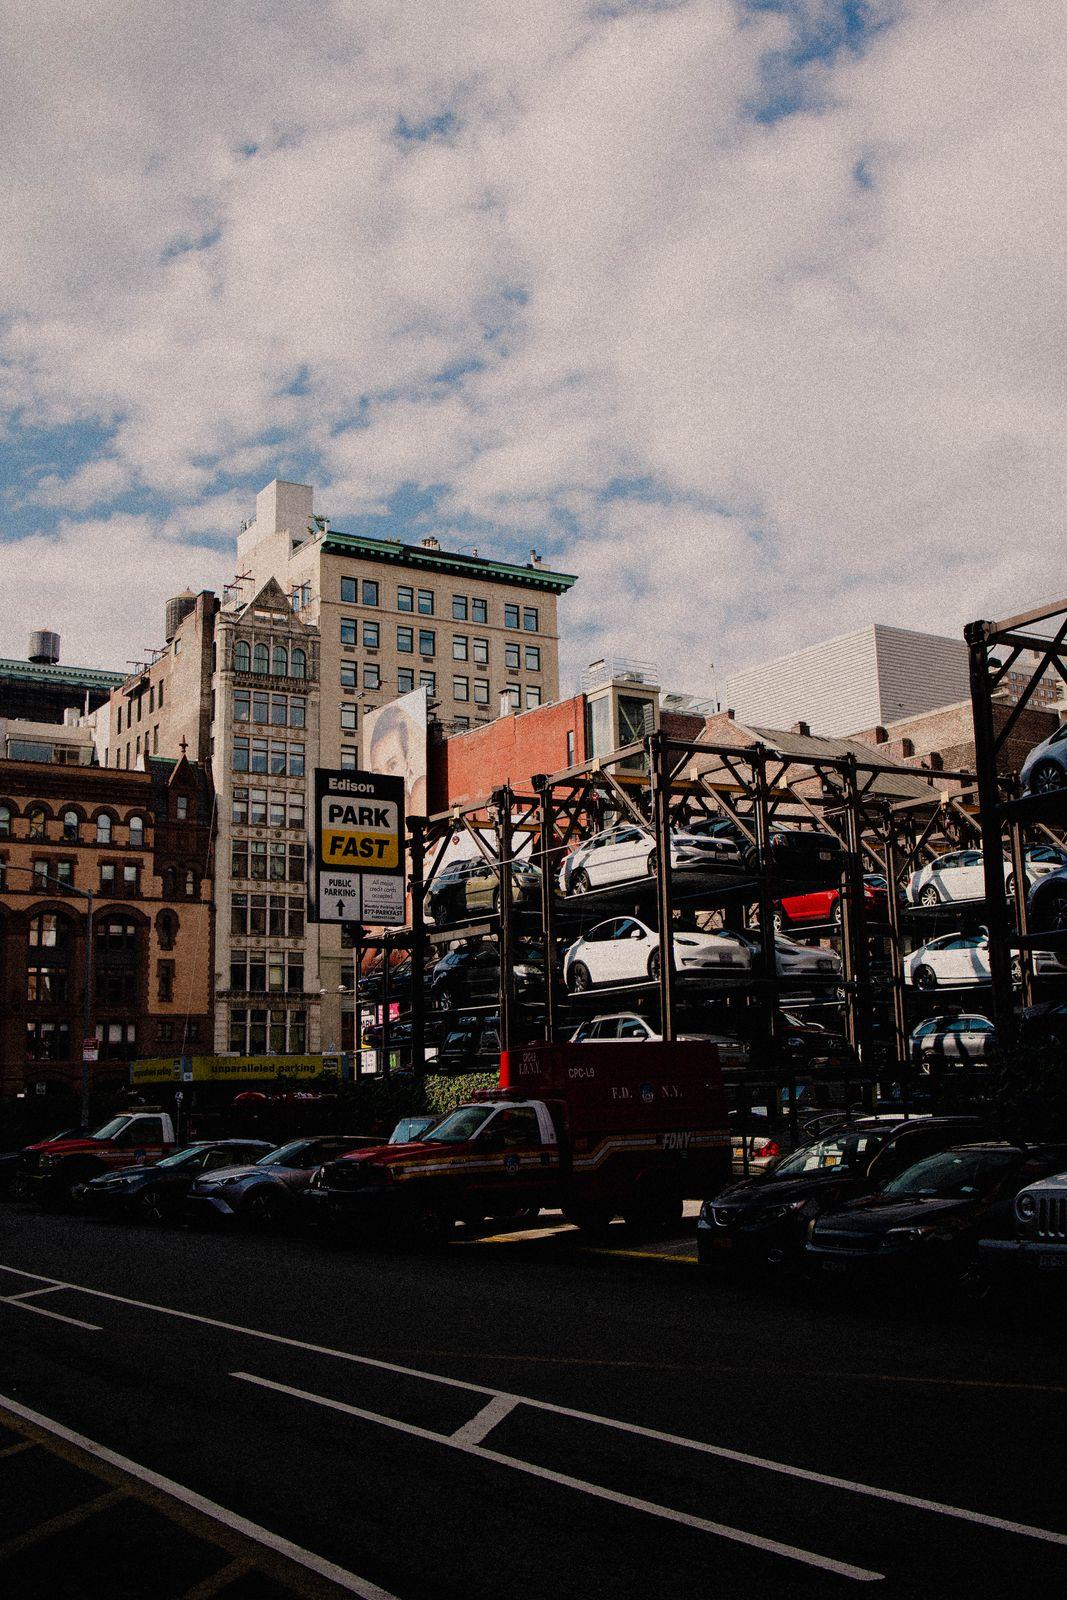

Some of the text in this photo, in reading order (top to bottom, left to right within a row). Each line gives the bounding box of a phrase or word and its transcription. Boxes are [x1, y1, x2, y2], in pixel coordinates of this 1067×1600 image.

[328, 777, 375, 793] Edison
[328, 804, 391, 828] PARK
[329, 835, 390, 859] FAST
[328, 878, 352, 888] PUBLIC
[324, 887, 356, 898] PARKING
[363, 908, 403, 916] 877-PARKFAST
[211, 1063, 275, 1074] unparalleled
[277, 1063, 316, 1075] parking
[662, 1131, 691, 1150] FDNY
